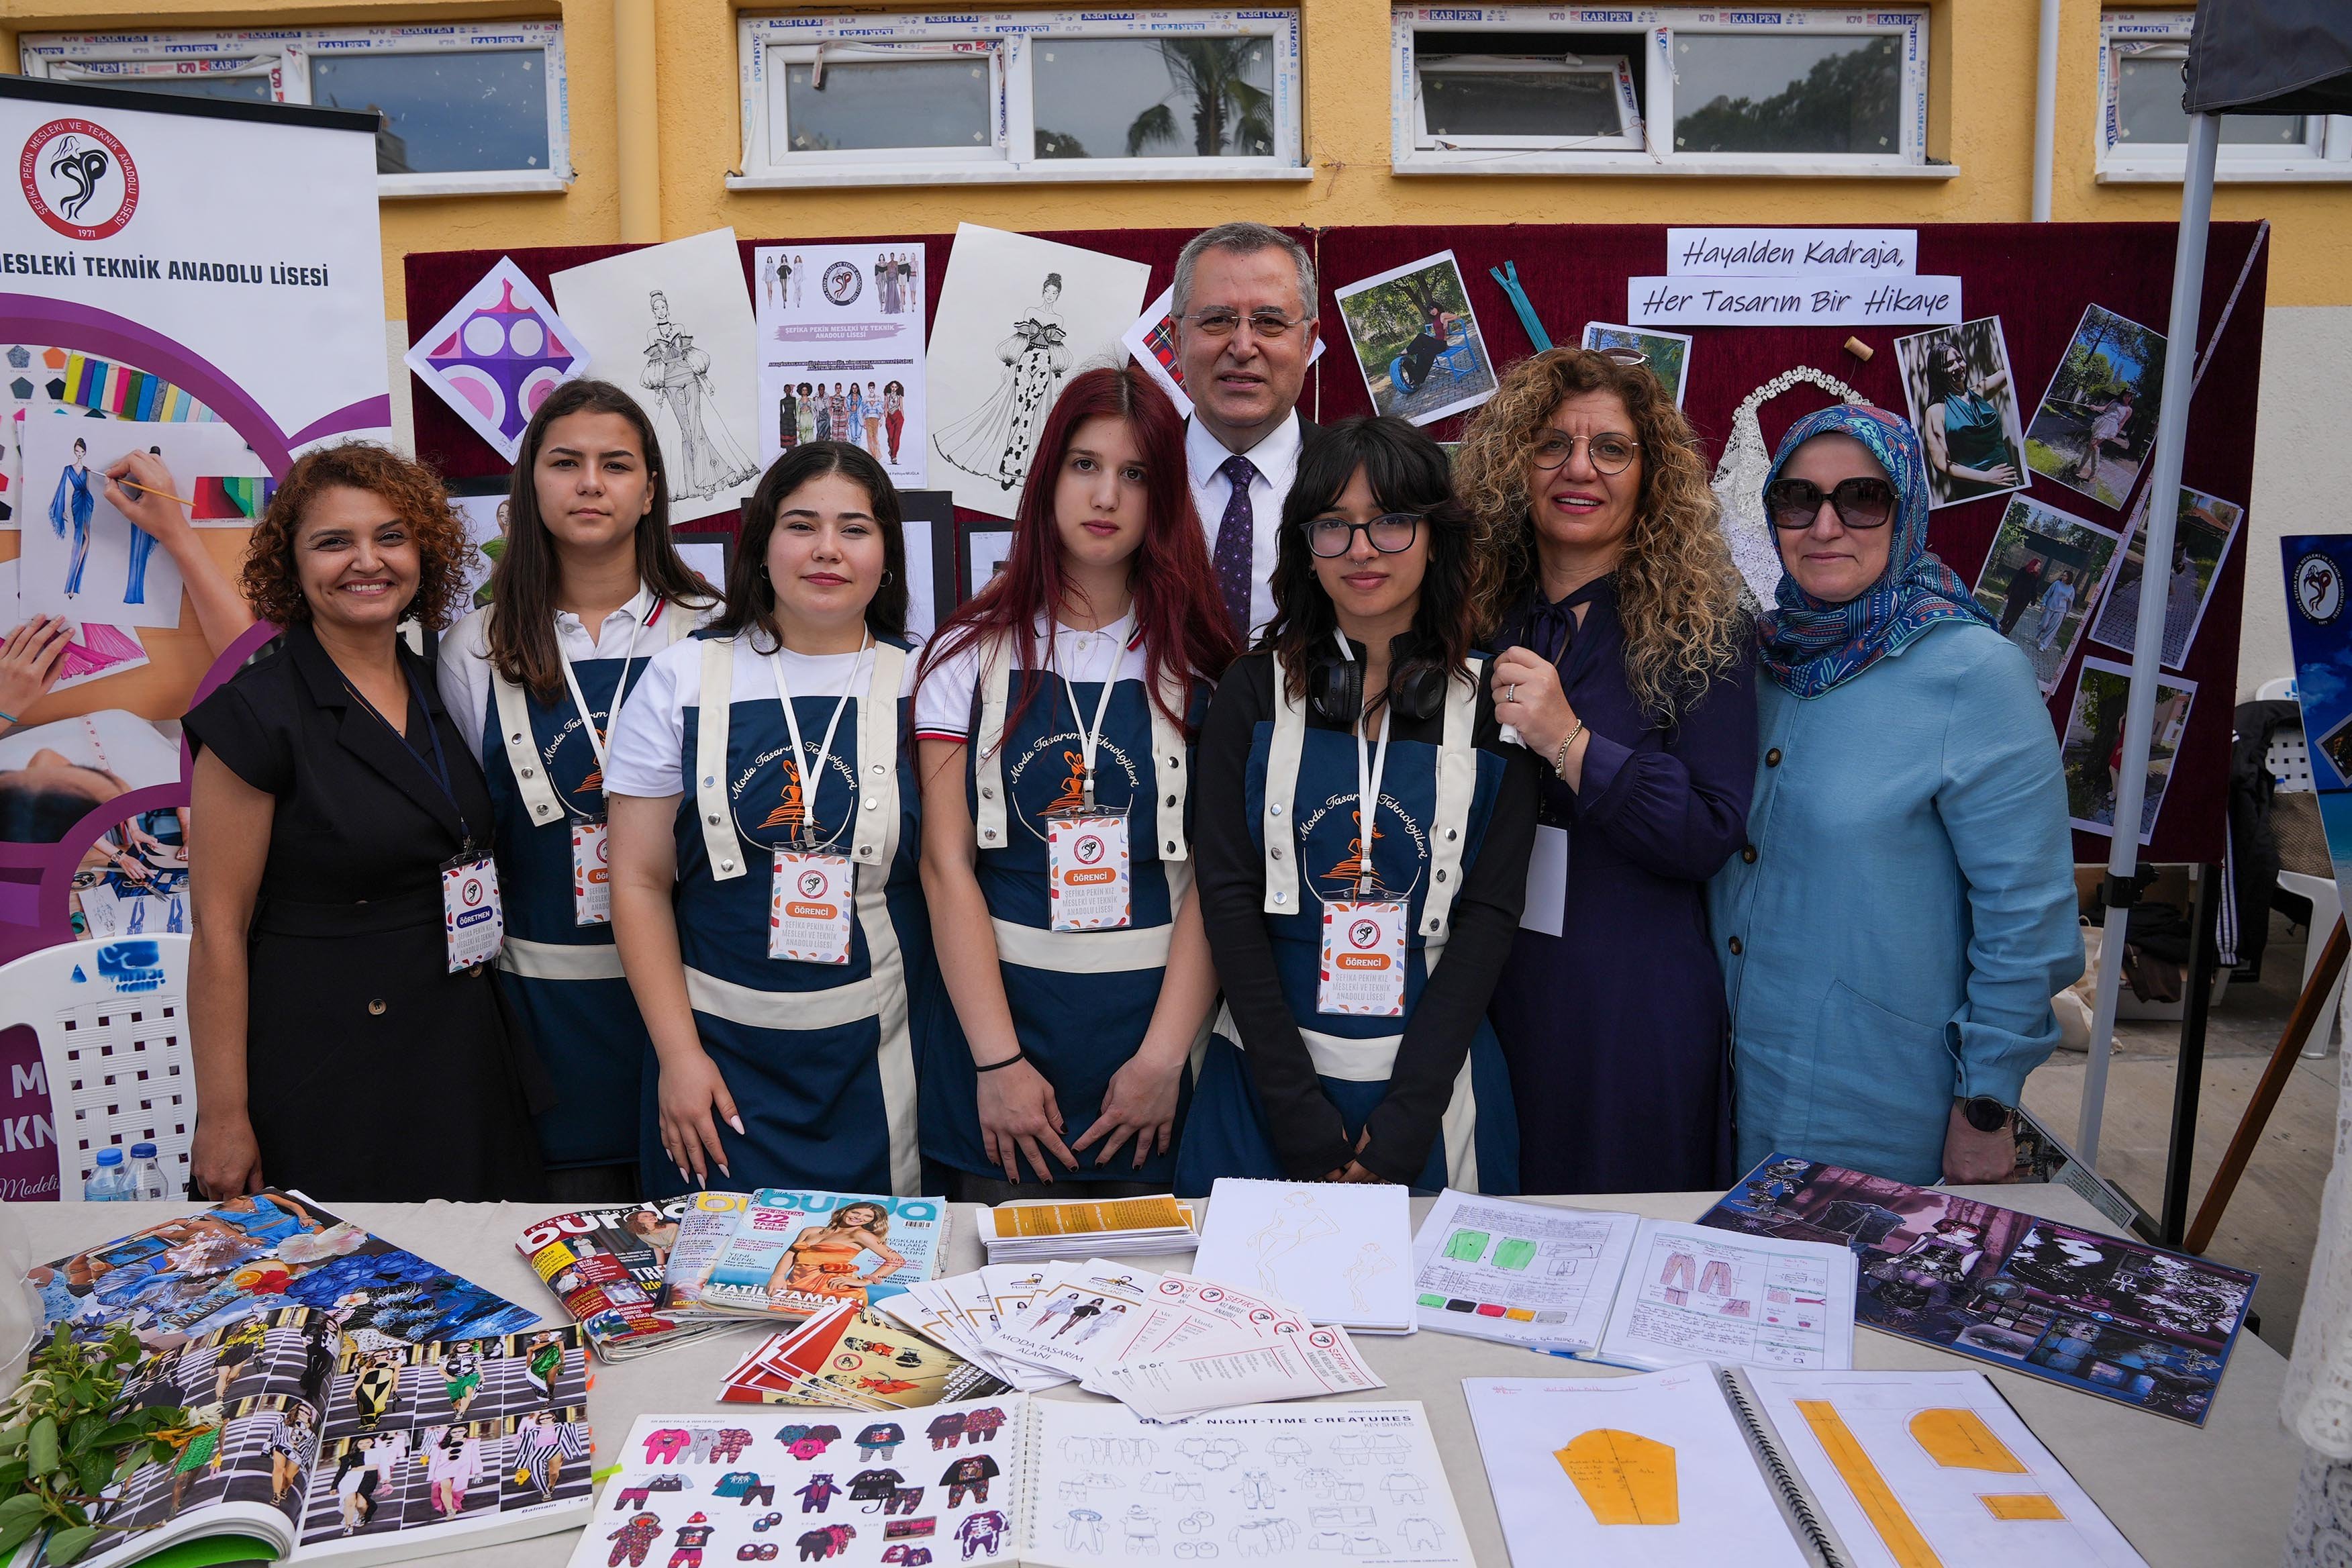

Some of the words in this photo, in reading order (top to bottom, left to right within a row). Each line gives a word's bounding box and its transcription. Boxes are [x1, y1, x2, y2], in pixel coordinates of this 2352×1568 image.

[1431, 11, 1454, 19] KAR
[1459, 11, 1479, 19] PEN
[1582, 12, 1606, 21] KAR
[1609, 12, 1630, 21] PEN
[1699, 14, 1715, 22] K70
[1730, 14, 1753, 23] KAR
[1757, 14, 1779, 23] PEN
[1847, 15, 1862, 23] K70
[1877, 15, 1900, 24] KAR
[98, 64, 117, 72] PEN
[177, 62, 196, 73] K70
[210, 60, 230, 70] KAR
[30, 121, 64, 149] MESLEKİ
[88, 125, 119, 150] TEKNİK
[23, 152, 34, 179] PEKİN
[119, 154, 136, 194] ANADOLU
[26, 184, 48, 215] ŞEFİKA
[114, 199, 136, 227] LİSESİ
[1683, 237, 1795, 268] Hayalden
[1804, 240, 1905, 268] Kadraja,
[0, 252, 76, 275] ESLEKİ
[83, 254, 161, 279] TEKNİK
[168, 260, 262, 284] ANADOLU
[271, 261, 328, 287] LİSESİ
[1643, 285, 1692, 315] Her
[1702, 289, 1800, 312] Tasarım
[1811, 291, 1853, 313] Bir
[1865, 285, 1949, 316] Hikaye
[542, 732, 566, 765] Moda
[1012, 750, 1034, 784] Moda
[1034, 732, 1081, 752] Tasarım
[732, 767, 756, 799] Moda
[755, 744, 795, 767] Tasarı
[1300, 807, 1325, 841] Moda
[1326, 793, 1360, 809] Tasar
[1377, 793, 1428, 860] Teknolojileri
[1073, 873, 1107, 882] ÖĞRENCİ
[1106, 887, 1114, 895] KIZ
[1063, 897, 1087, 907] MESLEKİ
[1097, 895, 1117, 905] TEKNİK
[795, 905, 828, 916] ÖĞRENCİ
[1067, 907, 1093, 916] ANADOLU
[1095, 905, 1112, 914] LİSESİ
[460, 910, 490, 925] ÖĞRETMEN
[785, 921, 803, 930] ŞEFİKA
[805, 922, 824, 930] PEKİN
[782, 928, 807, 939] MESLEKİ
[816, 931, 836, 940] TEKNİK
[786, 939, 812, 947] ANADOLU
[814, 939, 832, 948] LİSESİ
[1346, 956, 1381, 967] ÖĞRENCİ
[1336, 973, 1356, 981] ŞEFİKA
[1332, 981, 1358, 991] MESLEKİ
[1369, 983, 1390, 991] TEKNİK
[1336, 992, 1365, 1000] ANADOLU
[1366, 991, 1385, 1001] LİSESİ
[531, 1212, 595, 1232] EVRENSEL
[602, 1207, 638, 1215] MODA
[754, 1213, 789, 1223] 22
[714, 1283, 766, 1295] TATİL
[999, 1334, 1035, 1347] MODA
[1039, 1344, 1084, 1362] TASARIM
[1016, 1347, 1050, 1359] ALANI
[522, 1504, 556, 1513] Balmain
